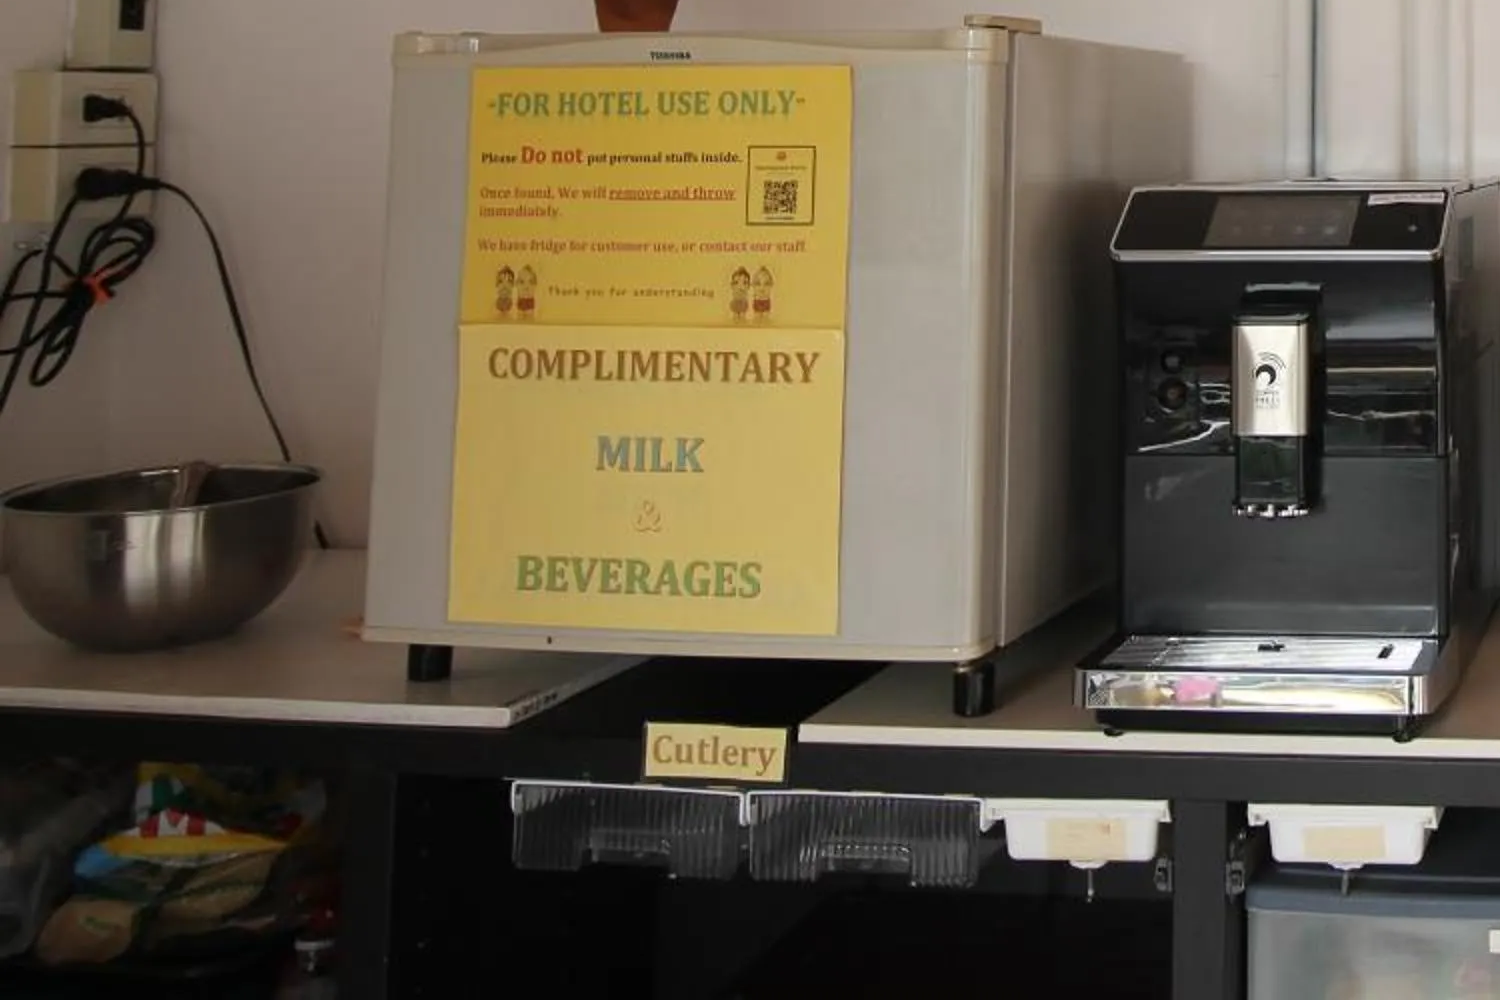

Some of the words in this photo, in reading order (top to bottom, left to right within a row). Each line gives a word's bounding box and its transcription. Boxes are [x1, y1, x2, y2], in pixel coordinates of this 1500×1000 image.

[650, 50, 692, 61] TOSHIBA
[557, 90, 650, 117] HOTEL
[656, 90, 711, 116] USE
[481, 151, 517, 164] Please
[521, 145, 547, 164] Do
[551, 147, 584, 164] not
[587, 152, 607, 166] put
[609, 151, 662, 166] personal
[665, 151, 699, 163] stuffs
[480, 186, 511, 200] Once
[558, 186, 580, 200] We
[582, 185, 607, 200] will
[609, 187, 662, 202] remove
[663, 186, 690, 202] and
[694, 185, 737, 202] throw
[478, 238, 496, 252] We
[500, 238, 528, 252] have
[530, 238, 566, 255] fridge
[569, 239, 588, 252] for
[591, 240, 649, 253] customer
[682, 242, 696, 252] or
[700, 240, 749, 252] contact
[750, 242, 772, 252] our
[548, 284, 580, 297] Thank
[585, 287, 605, 300] you
[610, 284, 627, 297] for
[633, 284, 715, 299] understanding
[488, 347, 821, 384] COMPLIMENTARY
[596, 435, 705, 472] MILK
[632, 499, 663, 532] &
[516, 554, 763, 599] BEVERAGES
[653, 735, 777, 776] Cutlery
